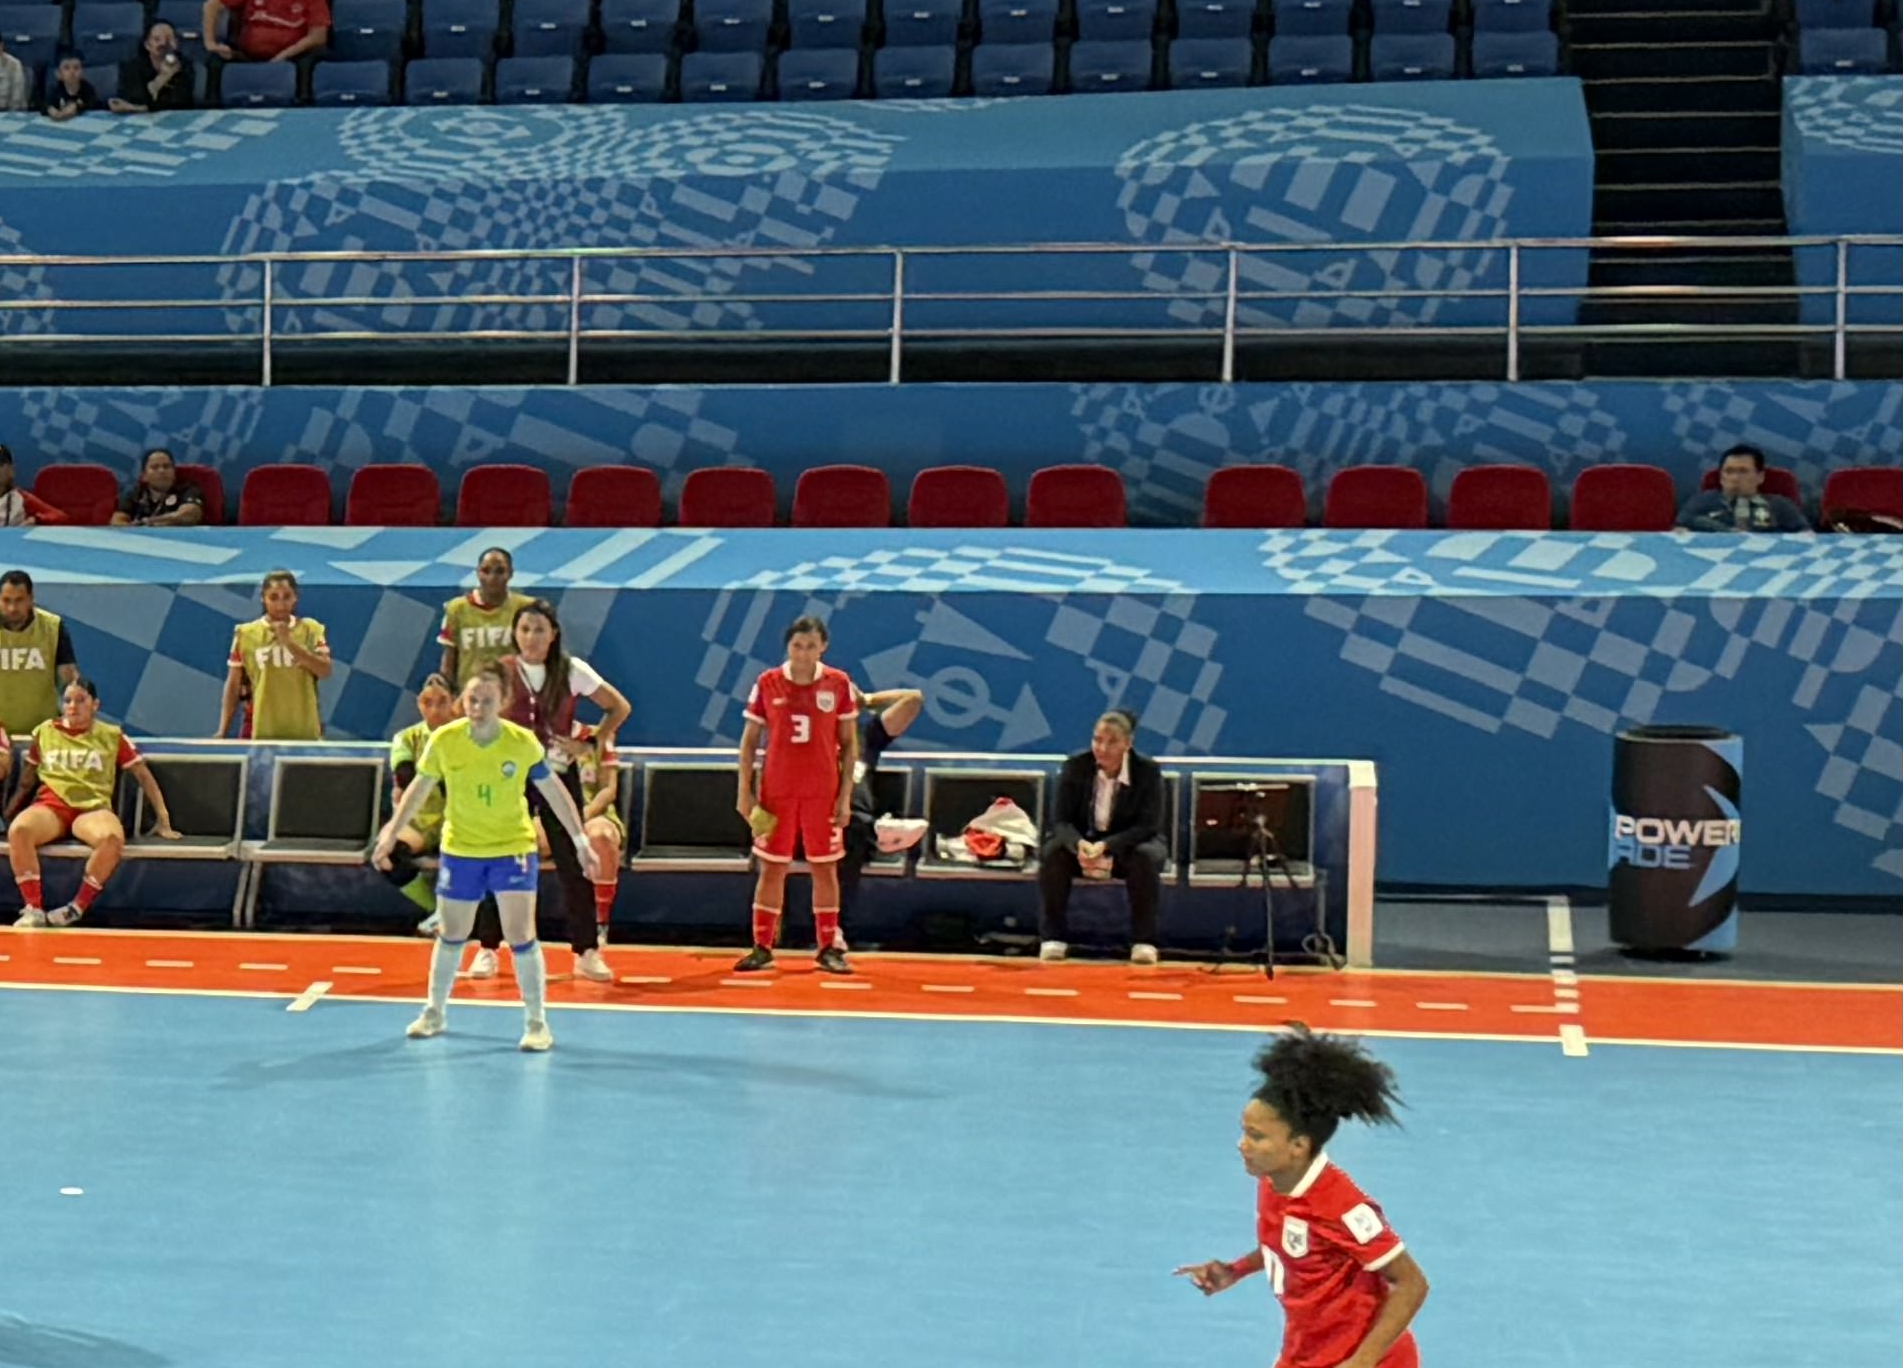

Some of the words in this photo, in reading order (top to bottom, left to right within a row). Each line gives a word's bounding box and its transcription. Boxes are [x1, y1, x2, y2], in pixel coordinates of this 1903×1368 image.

[791, 714, 810, 743] 3
[45, 748, 103, 772] FIFA
[477, 783, 492, 808] 4
